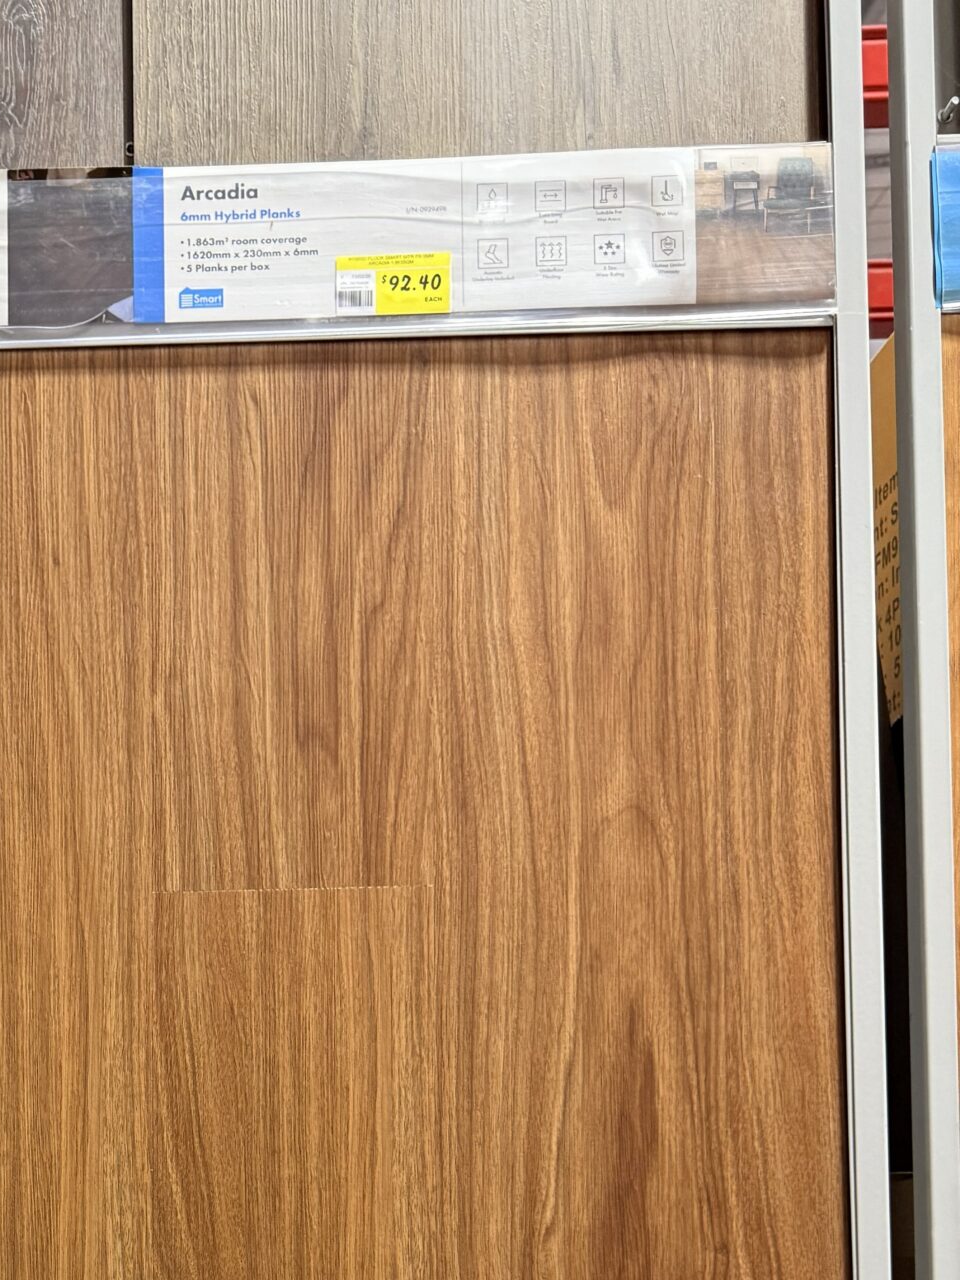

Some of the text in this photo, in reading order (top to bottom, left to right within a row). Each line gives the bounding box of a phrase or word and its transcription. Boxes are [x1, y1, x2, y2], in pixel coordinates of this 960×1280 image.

[180, 183, 258, 201] Arcadia
[180, 208, 301, 223] 6mm Hybrid Planks
[382, 273, 442, 292] $92.40
[194, 293, 222, 304] Smart
